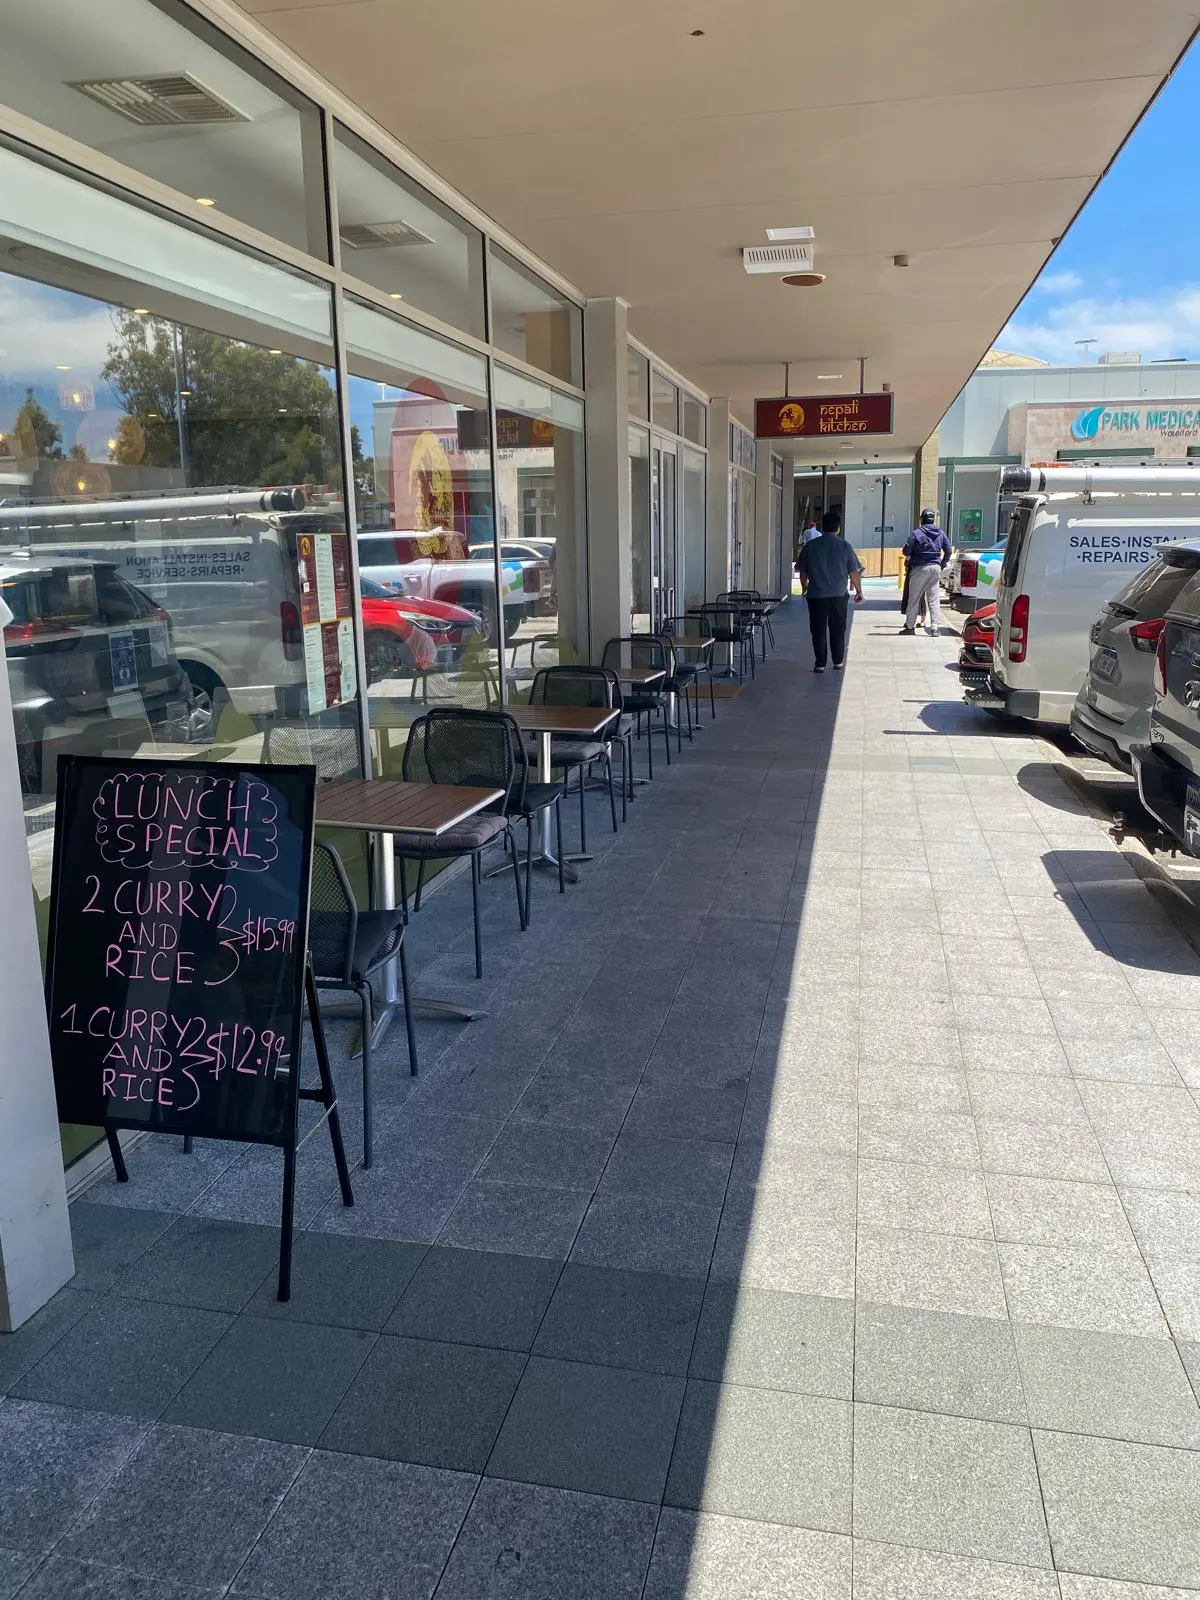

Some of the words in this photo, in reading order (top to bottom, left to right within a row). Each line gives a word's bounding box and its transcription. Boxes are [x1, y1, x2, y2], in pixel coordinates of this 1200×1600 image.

[819, 400, 860, 420] nepali
[819, 417, 869, 432] kitchen
[1102, 411, 1140, 431] PARK
[1160, 428, 1198, 437] Waterford
[114, 782, 250, 822] LUNCH
[117, 824, 261, 859] SPECIAL
[82, 875, 105, 914] 2
[114, 880, 223, 921] CURRY
[118, 920, 178, 950] AND
[241, 908, 295, 955] $15.99
[105, 943, 195, 984] RICE
[60, 1003, 83, 1034] 1
[88, 1006, 192, 1048] CURRY
[102, 1042, 173, 1072] AND
[206, 1022, 285, 1081] $12.99
[102, 1068, 175, 1106] RICE
